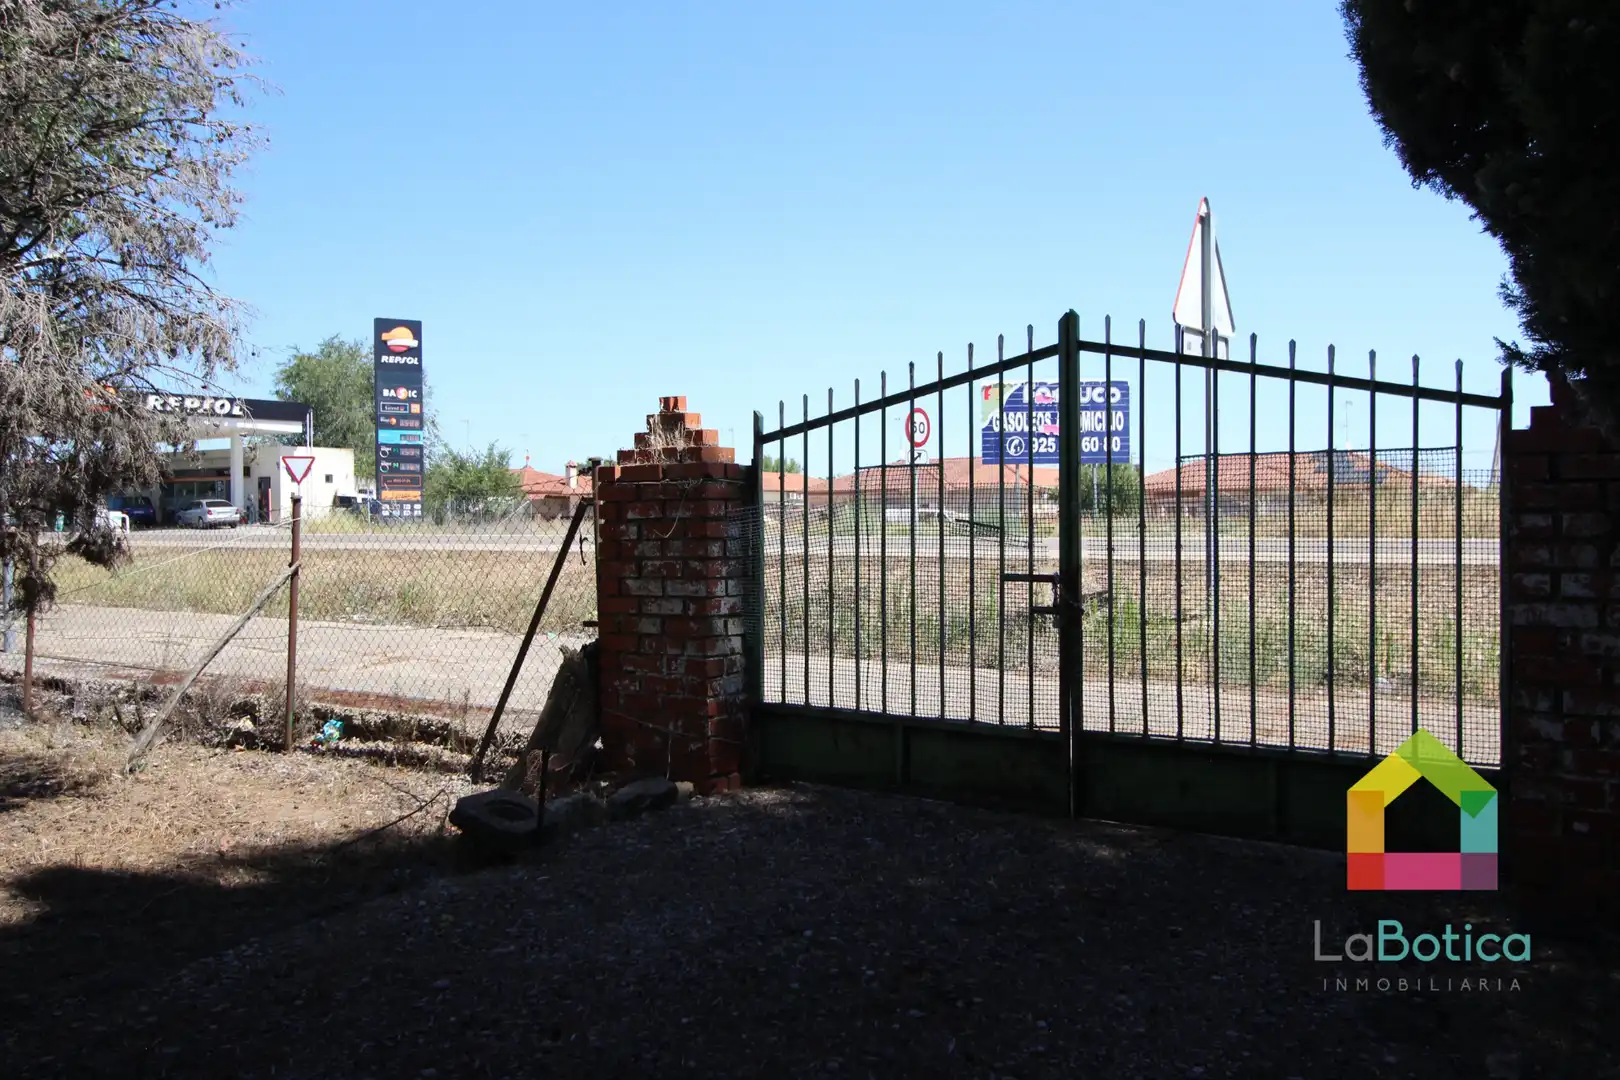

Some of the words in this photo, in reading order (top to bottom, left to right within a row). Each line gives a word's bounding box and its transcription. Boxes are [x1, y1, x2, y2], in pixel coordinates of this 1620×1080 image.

[381, 355, 420, 365] REPSOL
[382, 387, 418, 400] BASIC
[145, 394, 244, 415] REPSOL
[1031, 436, 1056, 453] 925
